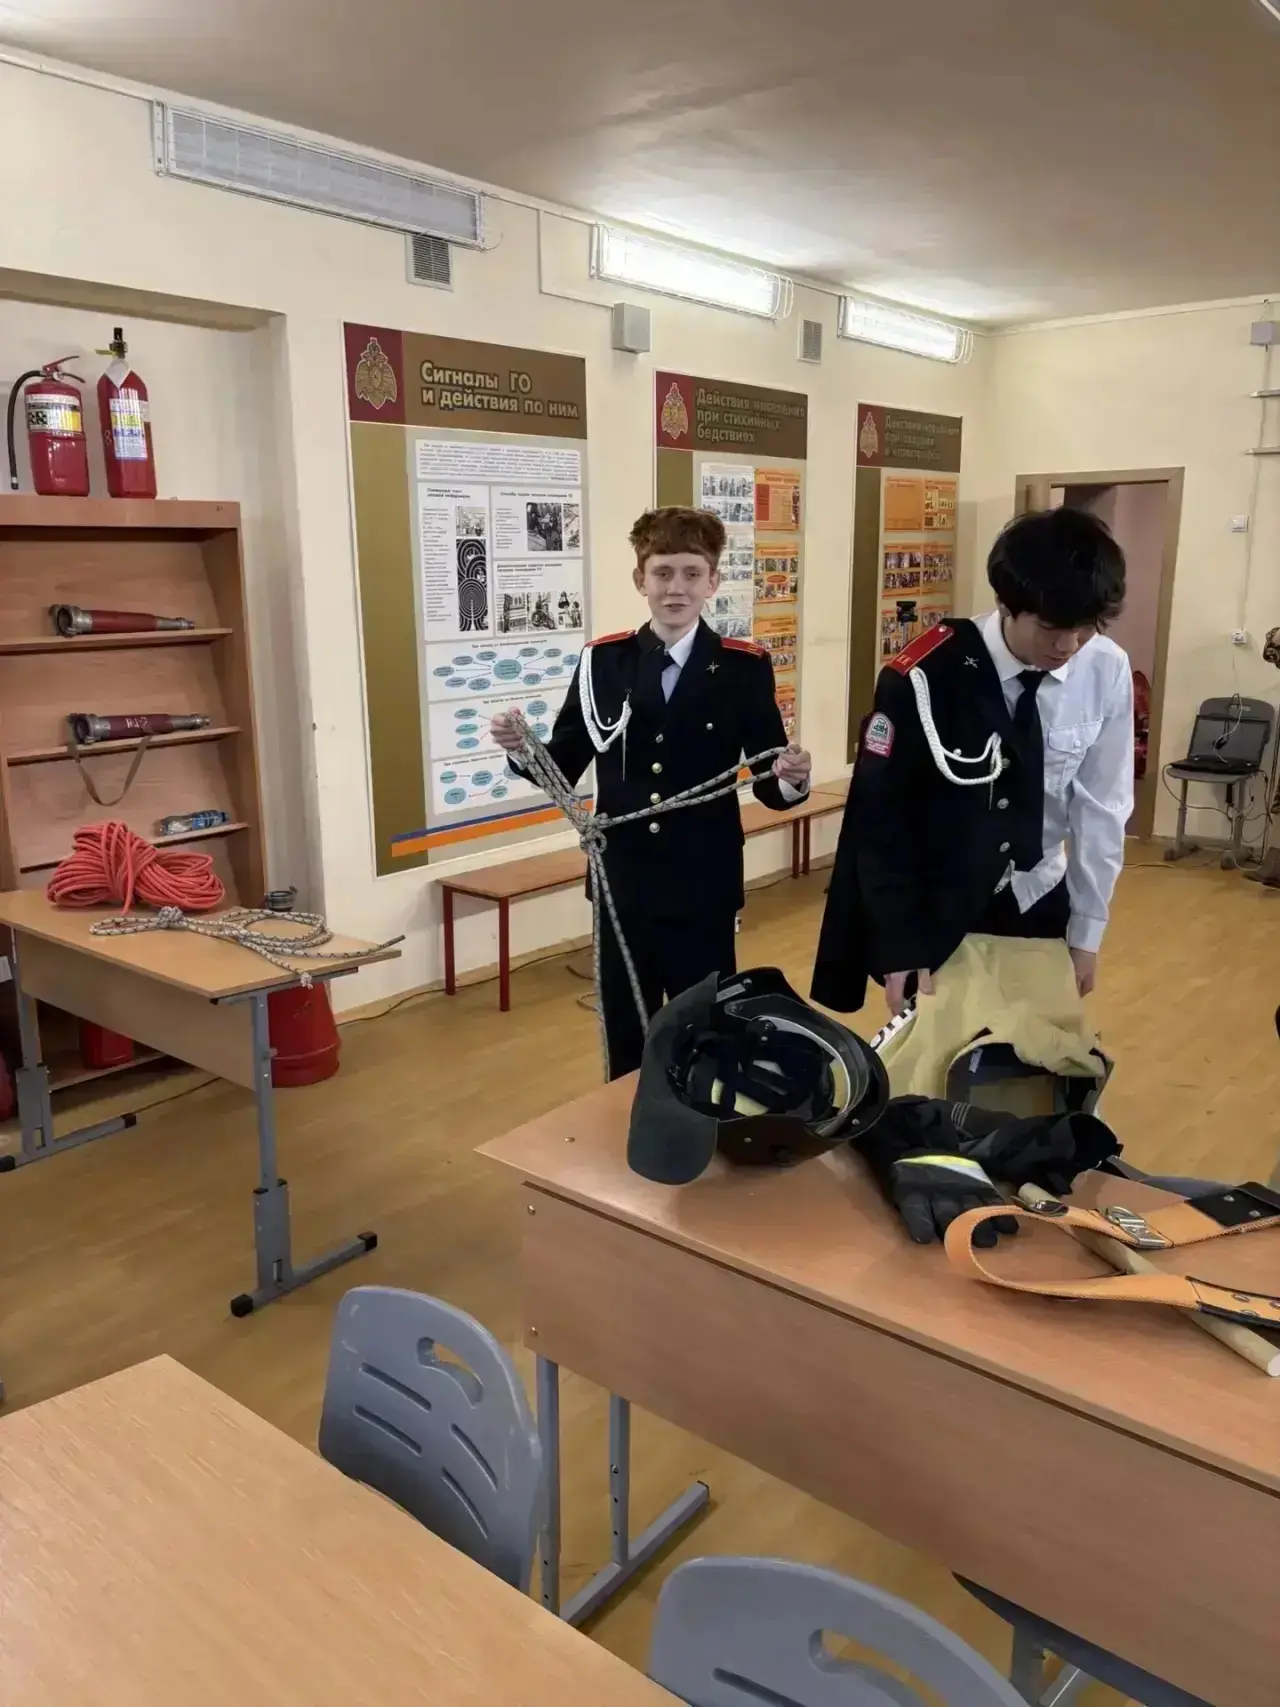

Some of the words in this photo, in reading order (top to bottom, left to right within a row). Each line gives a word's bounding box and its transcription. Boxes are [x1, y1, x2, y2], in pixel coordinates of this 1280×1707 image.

[421, 361, 498, 389] Сигналы
[510, 372, 531, 393] ГО
[422, 389, 434, 404] и
[440, 388, 518, 411] действия
[524, 401, 543, 413] по
[549, 403, 578, 418] ним
[697, 388, 750, 409] Действия
[697, 409, 719, 425] при
[723, 413, 780, 430] стихийных
[697, 423, 755, 443] бедствиях
